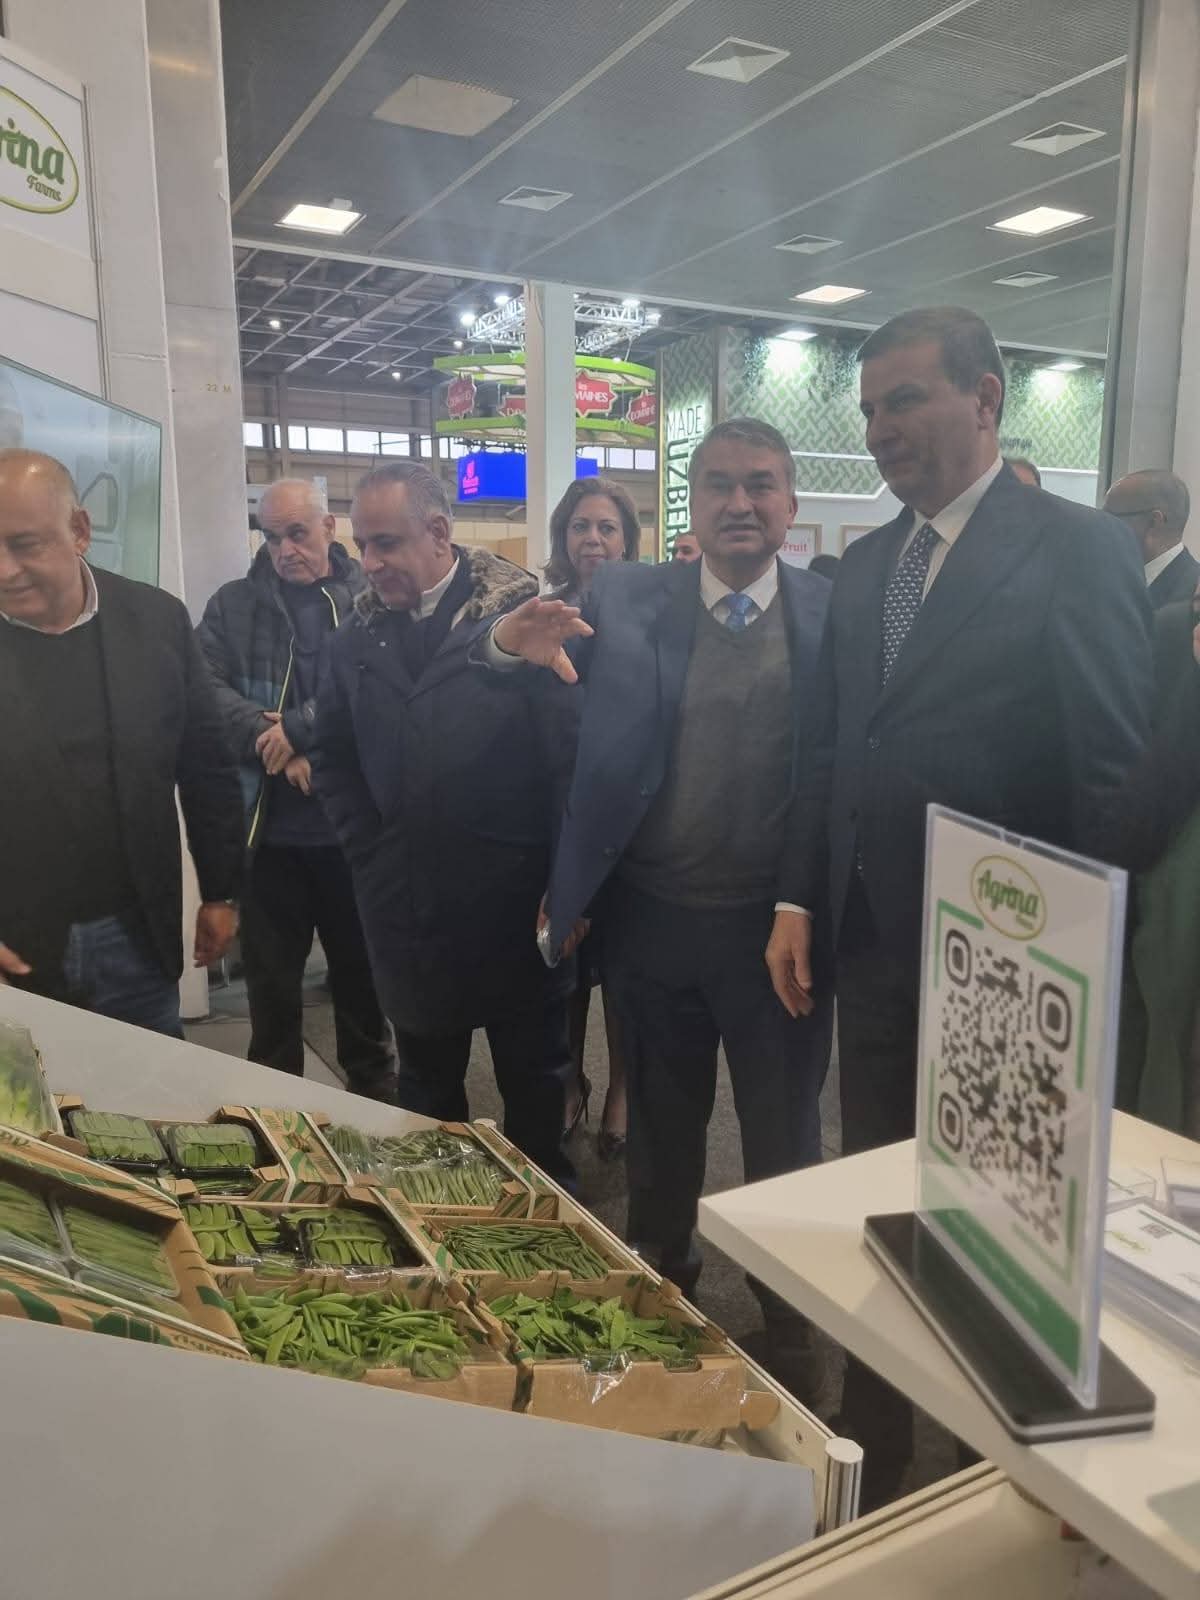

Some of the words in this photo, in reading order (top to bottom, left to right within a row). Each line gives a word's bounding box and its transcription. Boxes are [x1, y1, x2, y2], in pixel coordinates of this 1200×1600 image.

[26, 174, 62, 202] Farms
[666, 405, 703, 439] MADE
[783, 542, 808, 552] Fruit
[978, 869, 1039, 919] Agrina
